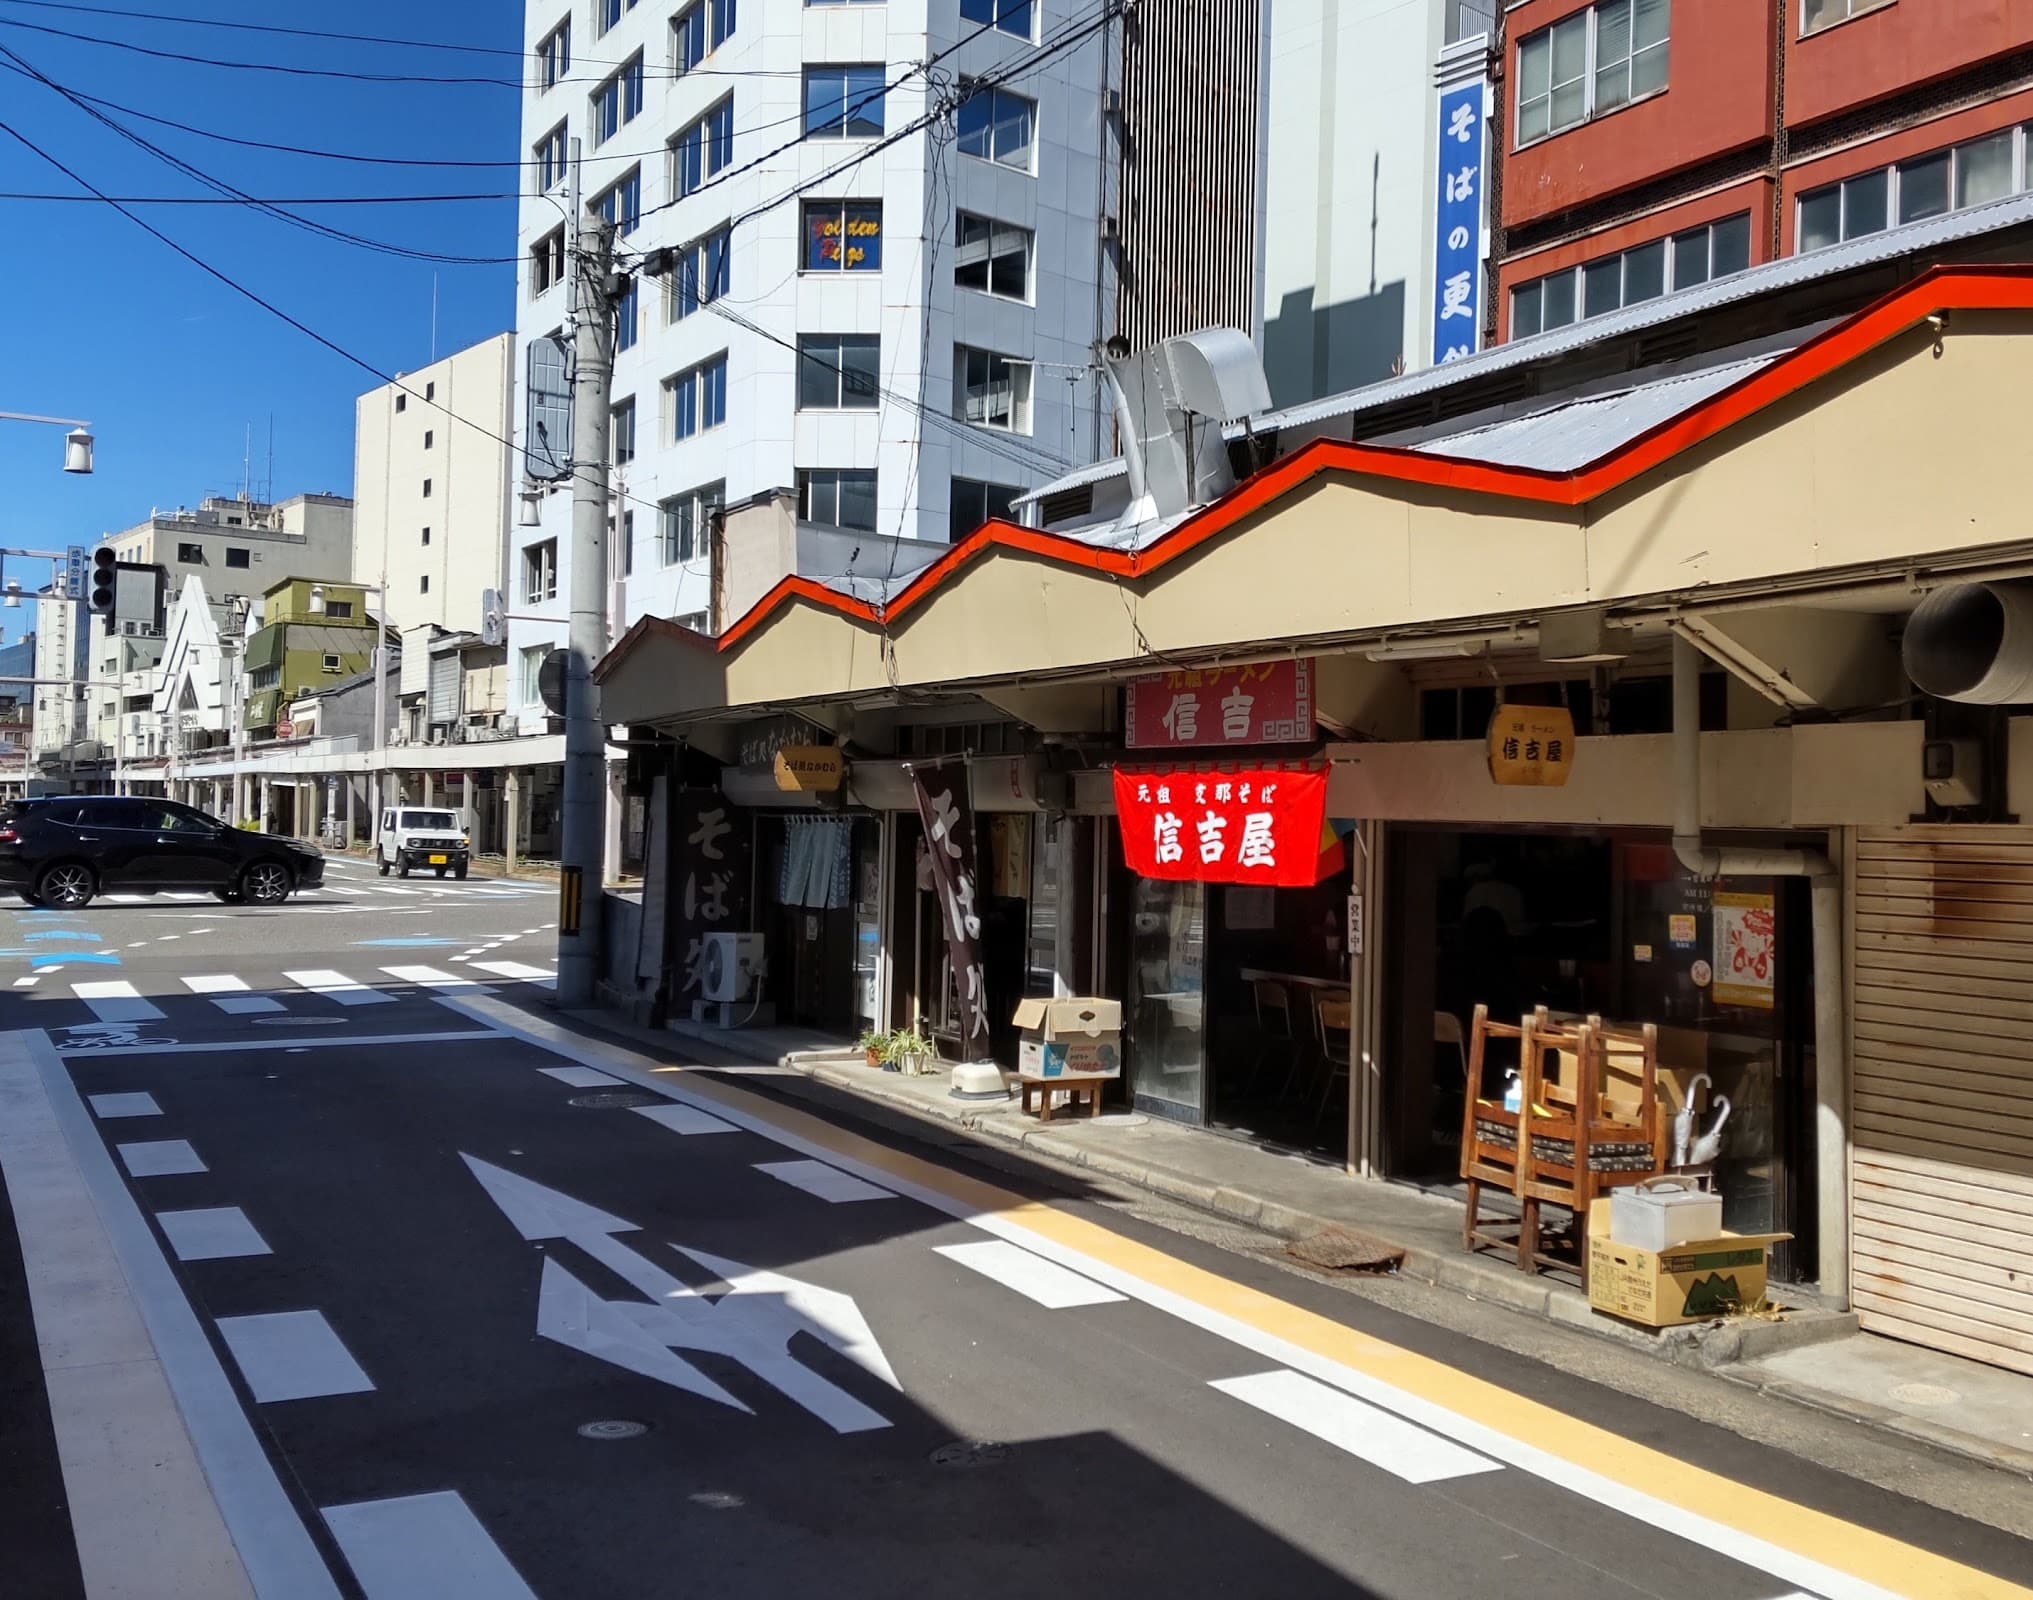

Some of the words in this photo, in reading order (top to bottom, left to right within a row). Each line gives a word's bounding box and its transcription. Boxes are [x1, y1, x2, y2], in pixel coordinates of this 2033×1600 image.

[1162, 686, 1255, 741] 信吉
[1503, 736, 1563, 762] 信吉屋
[1137, 784, 1171, 804] 元祖
[1195, 783, 1278, 804] 支那そば
[1154, 810, 1276, 868] 信吉屋
